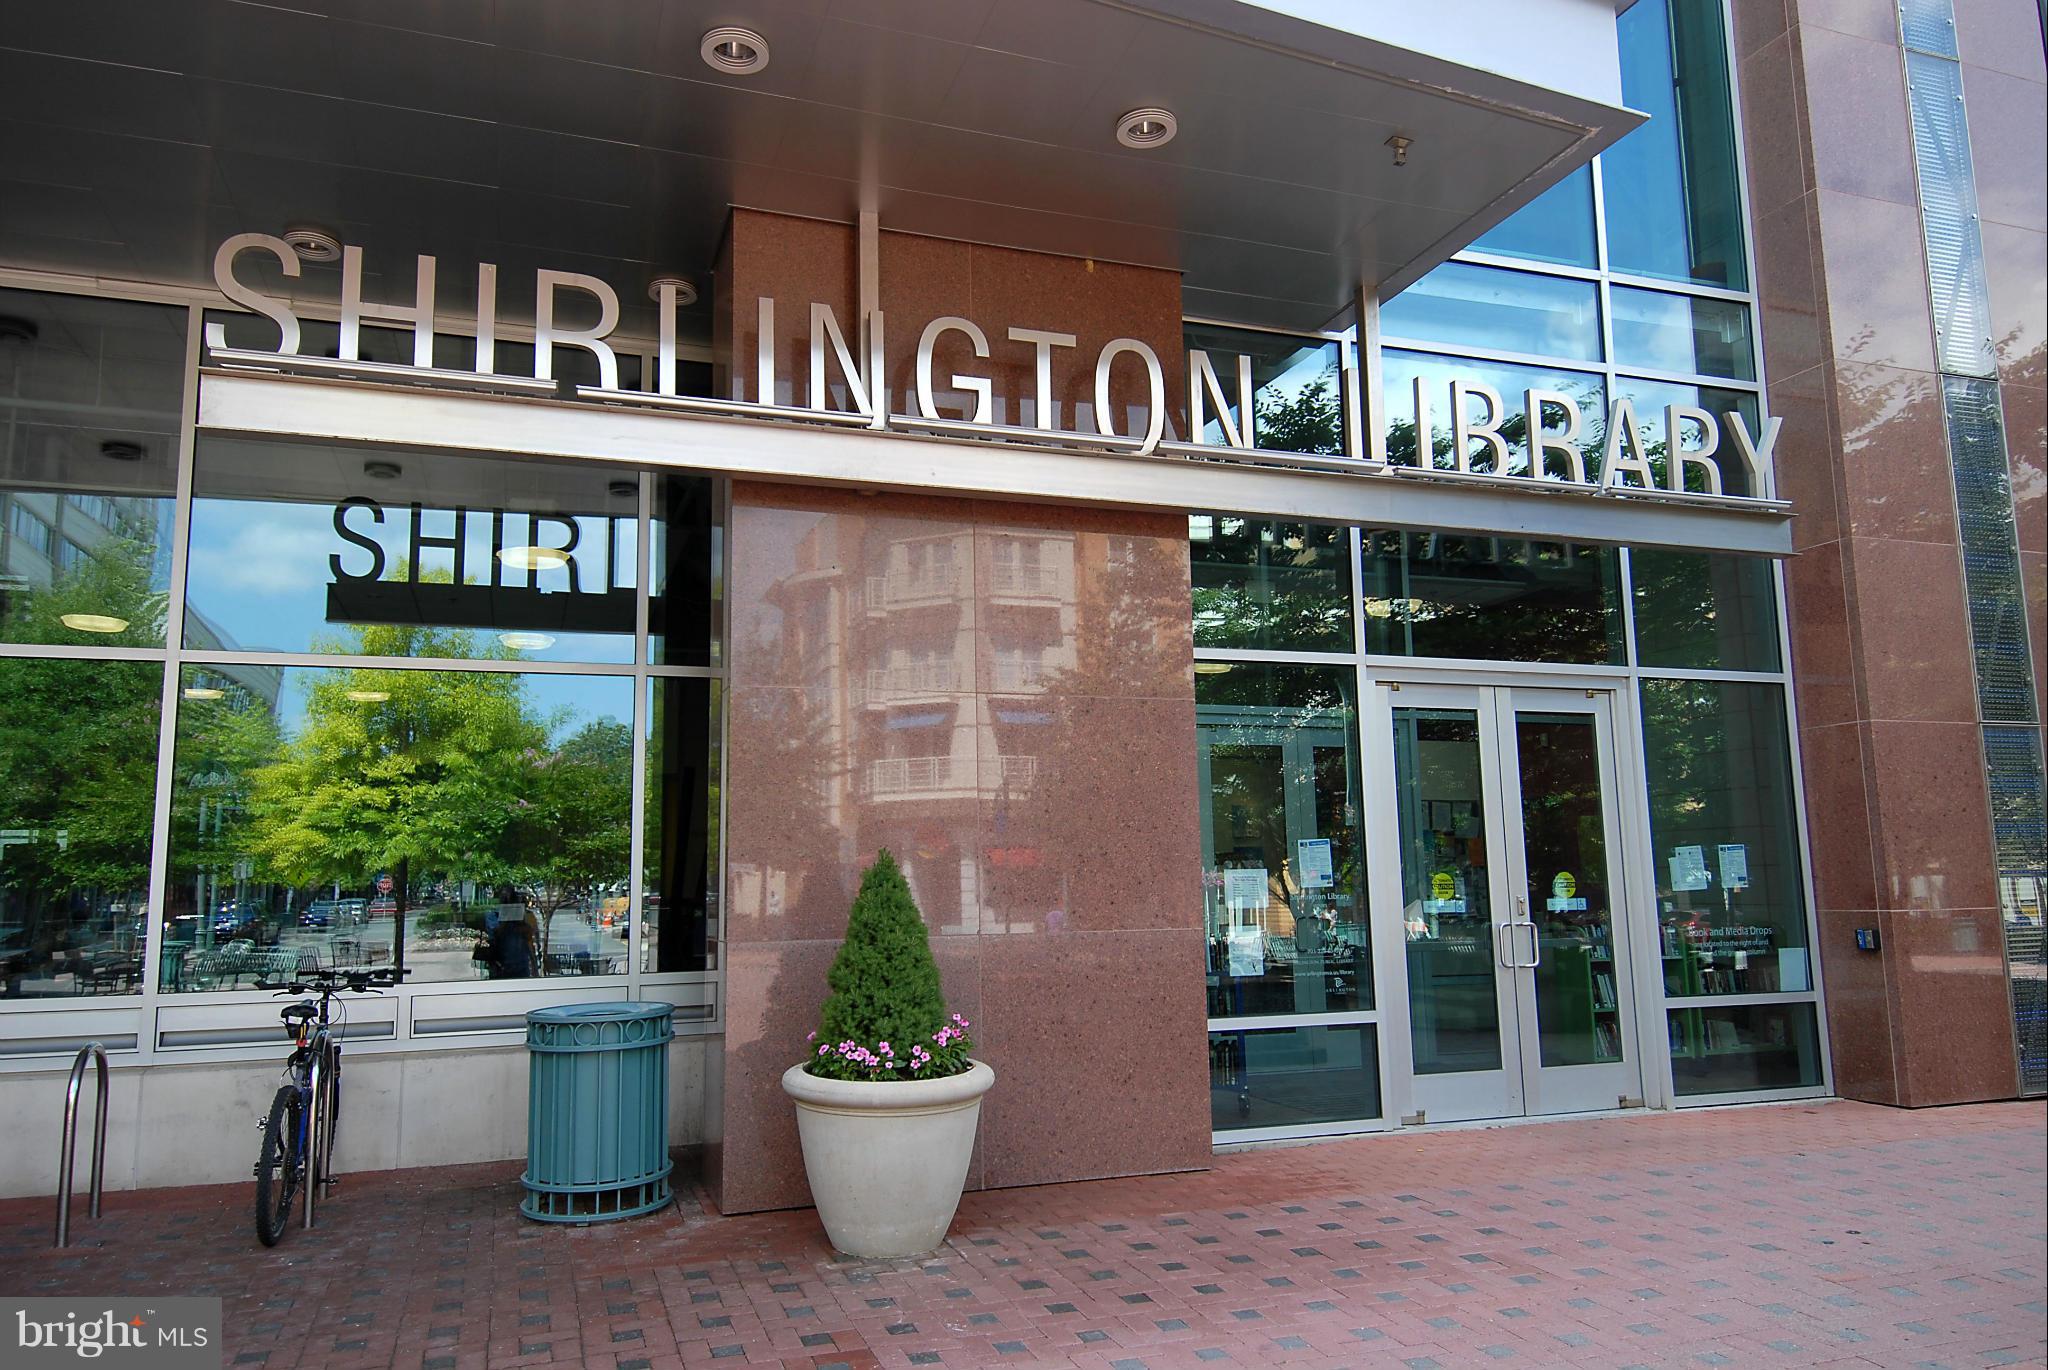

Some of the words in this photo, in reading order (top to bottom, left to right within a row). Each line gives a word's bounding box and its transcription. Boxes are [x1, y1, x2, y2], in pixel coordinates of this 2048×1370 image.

[206, 233, 1255, 463] SHIRLINGTON
[1342, 367, 1784, 502] LIBRARY
[1327, 892, 1349, 901] Library
[1688, 927, 1708, 937] Book
[1709, 926, 1724, 936] and
[1725, 926, 1748, 936] Media
[1749, 926, 1773, 937] Drops
